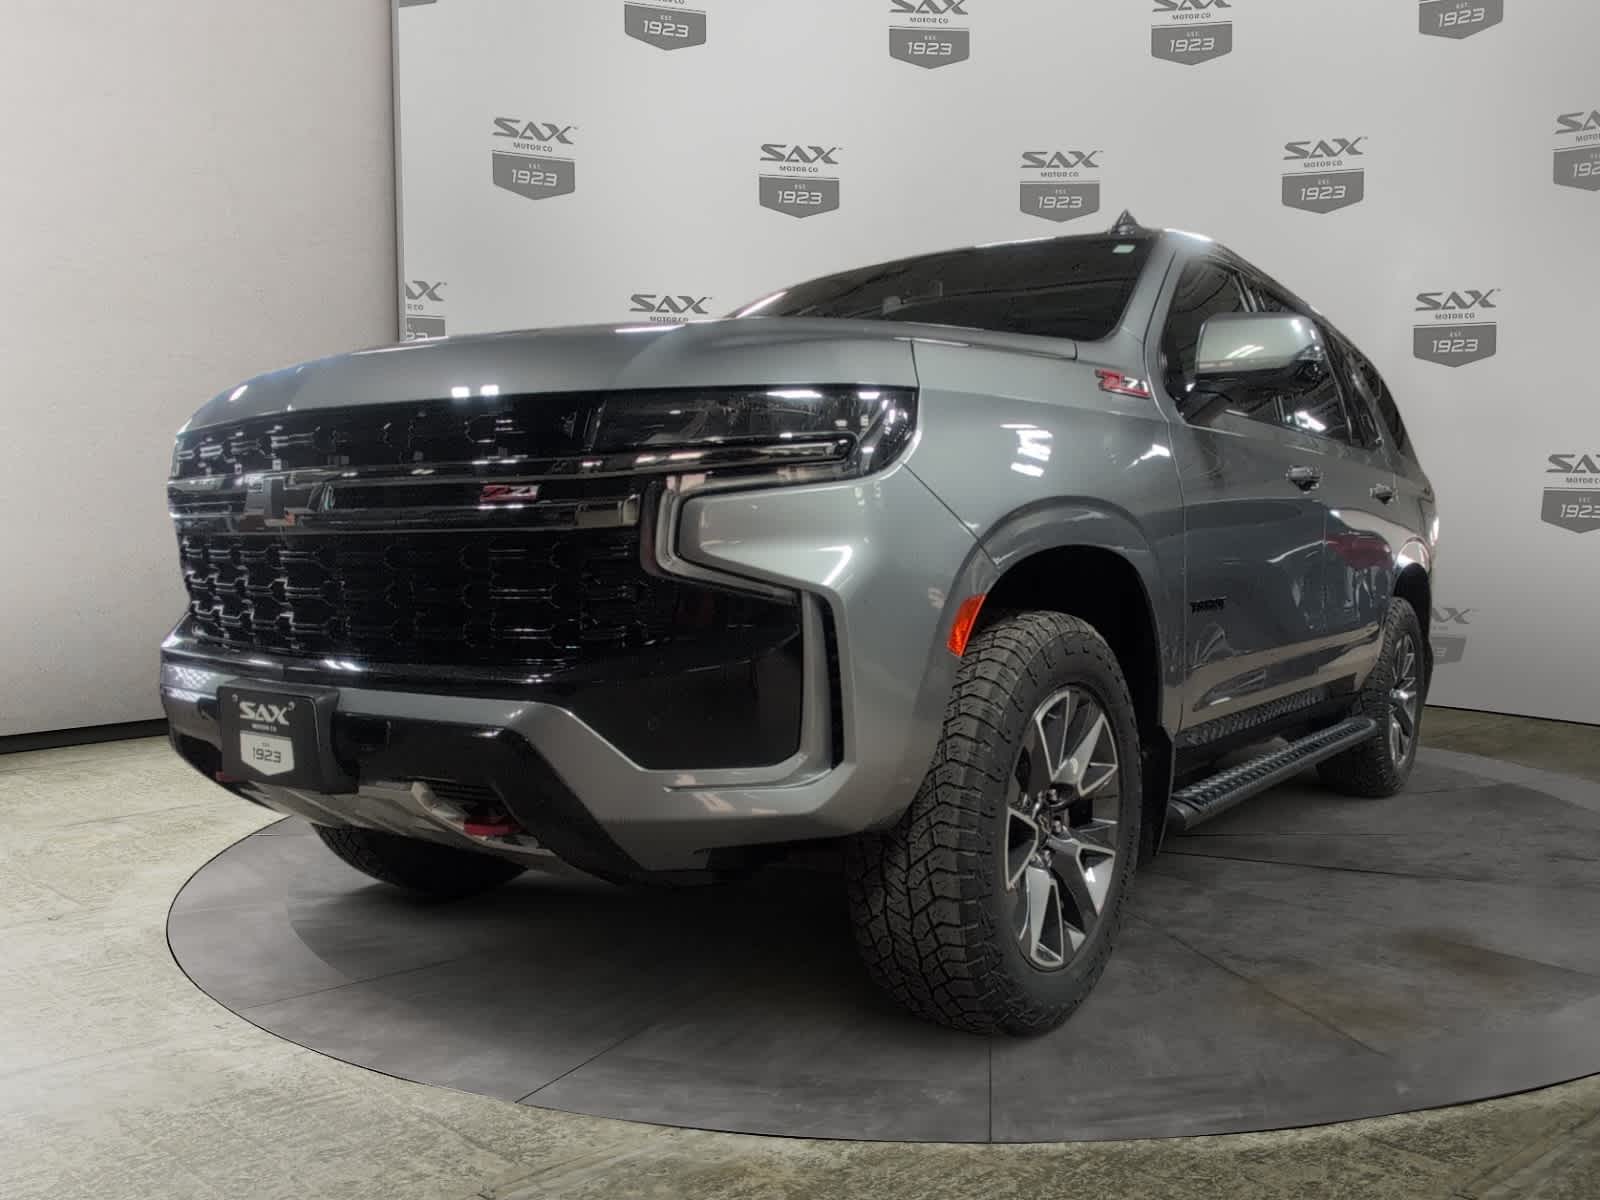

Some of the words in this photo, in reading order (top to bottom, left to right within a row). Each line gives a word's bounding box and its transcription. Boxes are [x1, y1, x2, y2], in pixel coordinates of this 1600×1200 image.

[890, 0, 968, 15] SAX
[1172, 13, 1200, 21] MOTOR
[1439, 7, 1485, 28] 1923
[643, 20, 689, 38] 1923
[907, 42, 952, 55] 1923
[1169, 38, 1215, 53] 1923
[492, 117, 574, 145] SAX
[1554, 110, 1600, 135] SA
[513, 142, 541, 151] MOTOR
[1575, 133, 1600, 143] MOTO
[759, 143, 839, 164] SAX
[1283, 136, 1363, 160] SAX
[1020, 150, 1099, 169] SAX
[511, 168, 557, 187] 1923
[779, 165, 806, 173] MOTOR
[1573, 161, 1600, 177] 192
[777, 190, 822, 205] 1923
[1300, 185, 1346, 201] 1923
[1038, 195, 1082, 209] 1923
[629, 293, 709, 314] SAX
[1414, 288, 1497, 312] SAX
[1432, 338, 1479, 353] 1923
[1095, 367, 1151, 399] Z71
[1546, 453, 1600, 473] SA
[239, 700, 290, 726] SAX
[252, 747, 281, 764] 1923
